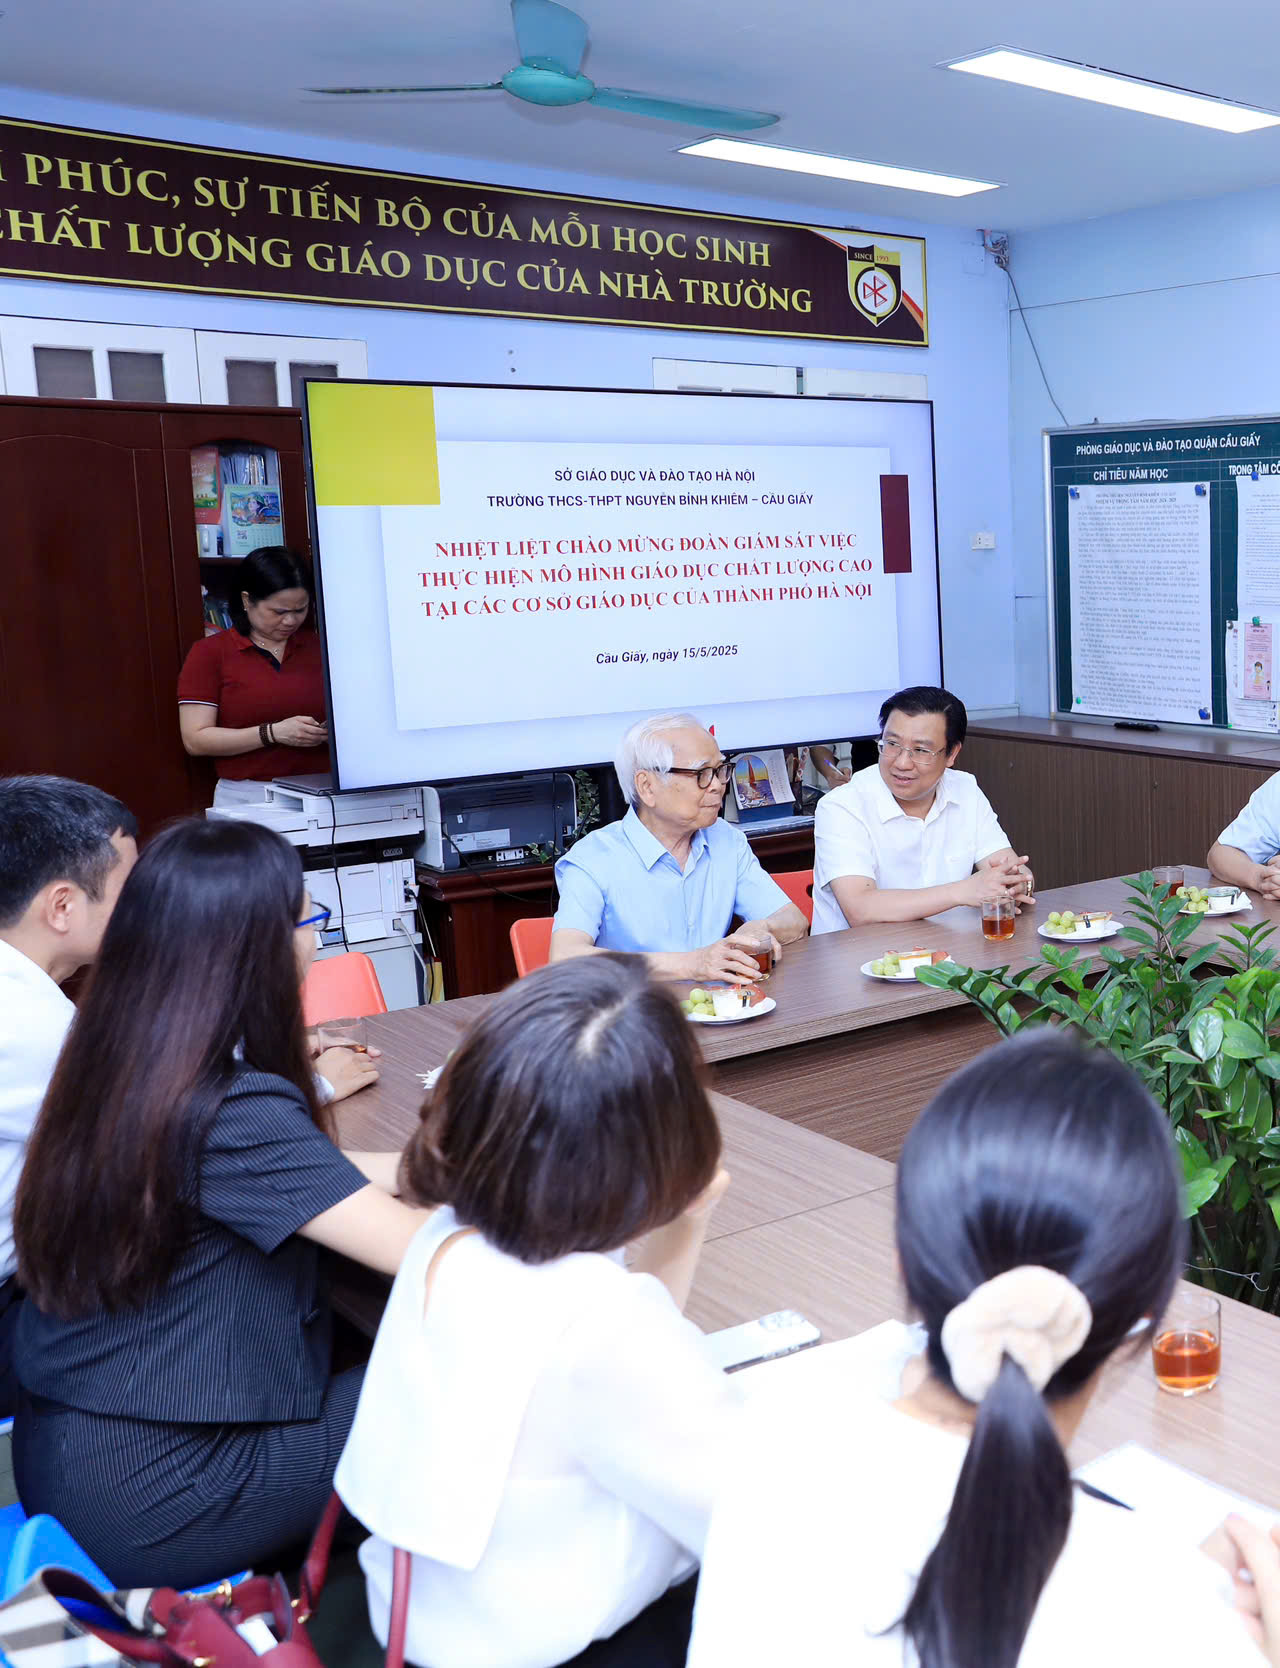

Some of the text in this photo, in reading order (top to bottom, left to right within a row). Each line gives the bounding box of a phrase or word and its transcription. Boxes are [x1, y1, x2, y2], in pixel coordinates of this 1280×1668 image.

[21, 153, 180, 208] PHÚC,
[194, 176, 249, 217] SỰ
[259, 181, 361, 225] TIẾN
[375, 196, 431, 237] BỘ
[443, 203, 521, 242] CỦA
[529, 212, 601, 249] MỖI
[612, 226, 687, 262] HỌC
[695, 236, 772, 267] SINH
[0, 204, 813, 313] HẤT LƯỢNG GIÁO DỤC CỦA NHÀ TRƯỜNG
[854, 252, 872, 260] SINCE
[1076, 442, 1102, 455] PHÒNG
[1104, 441, 1122, 454] GIÁO
[1124, 442, 1141, 455] DỤC
[1142, 438, 1153, 451] VÀ
[1155, 437, 1173, 451] ĐÀO
[1175, 439, 1191, 453] TẠO
[1194, 436, 1218, 451] QUẬN
[1240, 432, 1261, 447] GIẤY
[555, 467, 755, 484] SỞ GIÁO DỤC VÀ ĐÀO TẠO HÀ NỘI
[1093, 467, 1168, 481] CHỈ TIÊU NĂM HỌC
[487, 493, 544, 507] TRƯỜNG
[548, 495, 622, 507] THCS-THPT
[679, 492, 708, 505] BỈNH
[711, 492, 748, 505] KHIÊM
[761, 492, 785, 505] CẦU
[788, 491, 813, 504] GIẤY
[435, 531, 856, 560] NHIỆT LIỆT CHÀO MỪNG ĐOÀN GIÁM SÁT VIỆC
[418, 557, 872, 590] THỰC HIỆN MÔ HÌNH GIÁO DỤC CHẤT LƯỢNG CAO
[421, 581, 872, 620] TẠI CÁC CƠ SỞ GIÁO DỤC CỦA THÀNH PHỐ HÀ NỘI
[596, 645, 738, 664] Cầu Giấy, ngày 15/5/2025
